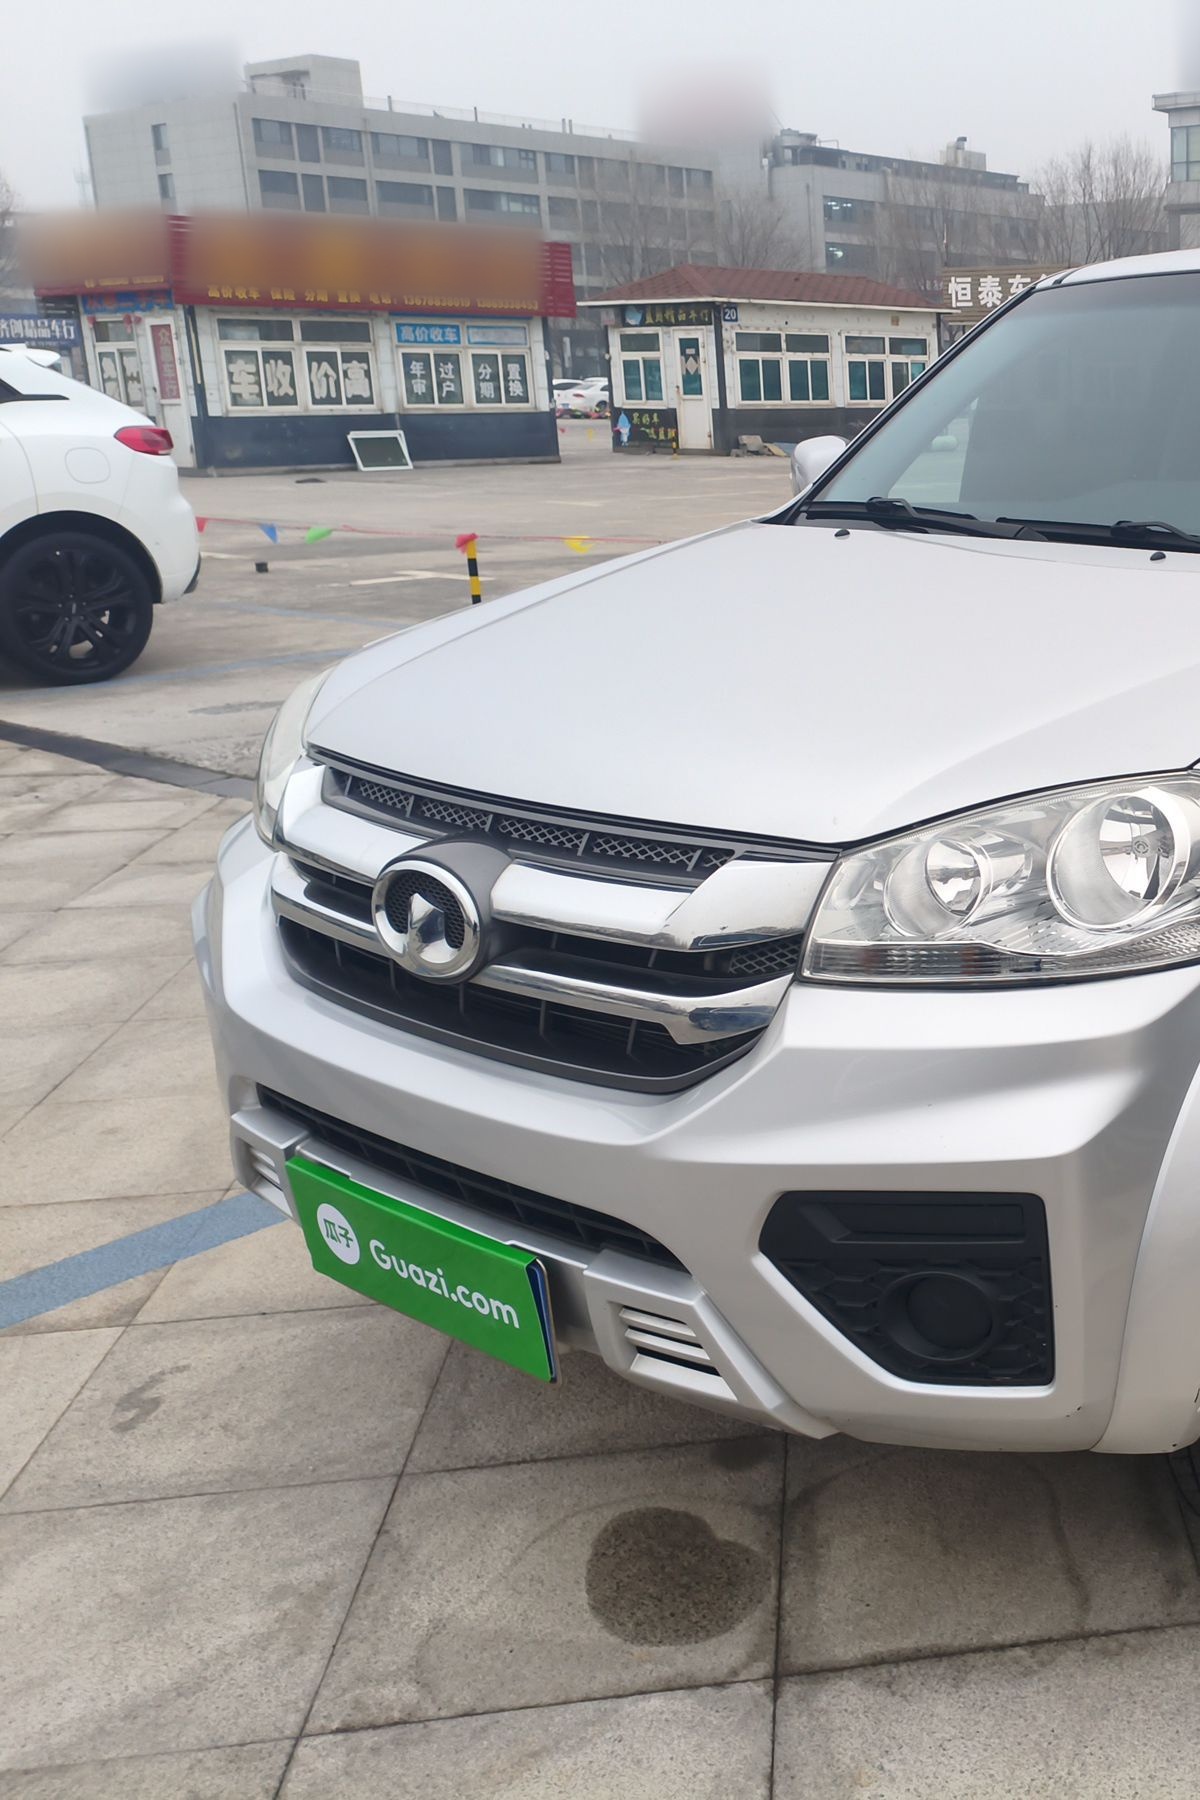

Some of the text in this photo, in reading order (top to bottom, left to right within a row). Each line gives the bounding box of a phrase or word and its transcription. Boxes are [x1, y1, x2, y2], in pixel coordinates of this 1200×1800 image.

[724, 308, 737, 321] 20
[400, 325, 459, 343] 高价收车
[409, 360, 427, 396] 年审
[439, 362, 456, 398] 过户
[478, 362, 495, 399] 分期
[506, 363, 524, 397] 置换
[322, 1218, 354, 1248] 瓜子
[369, 1238, 520, 1329] Guazi.com
